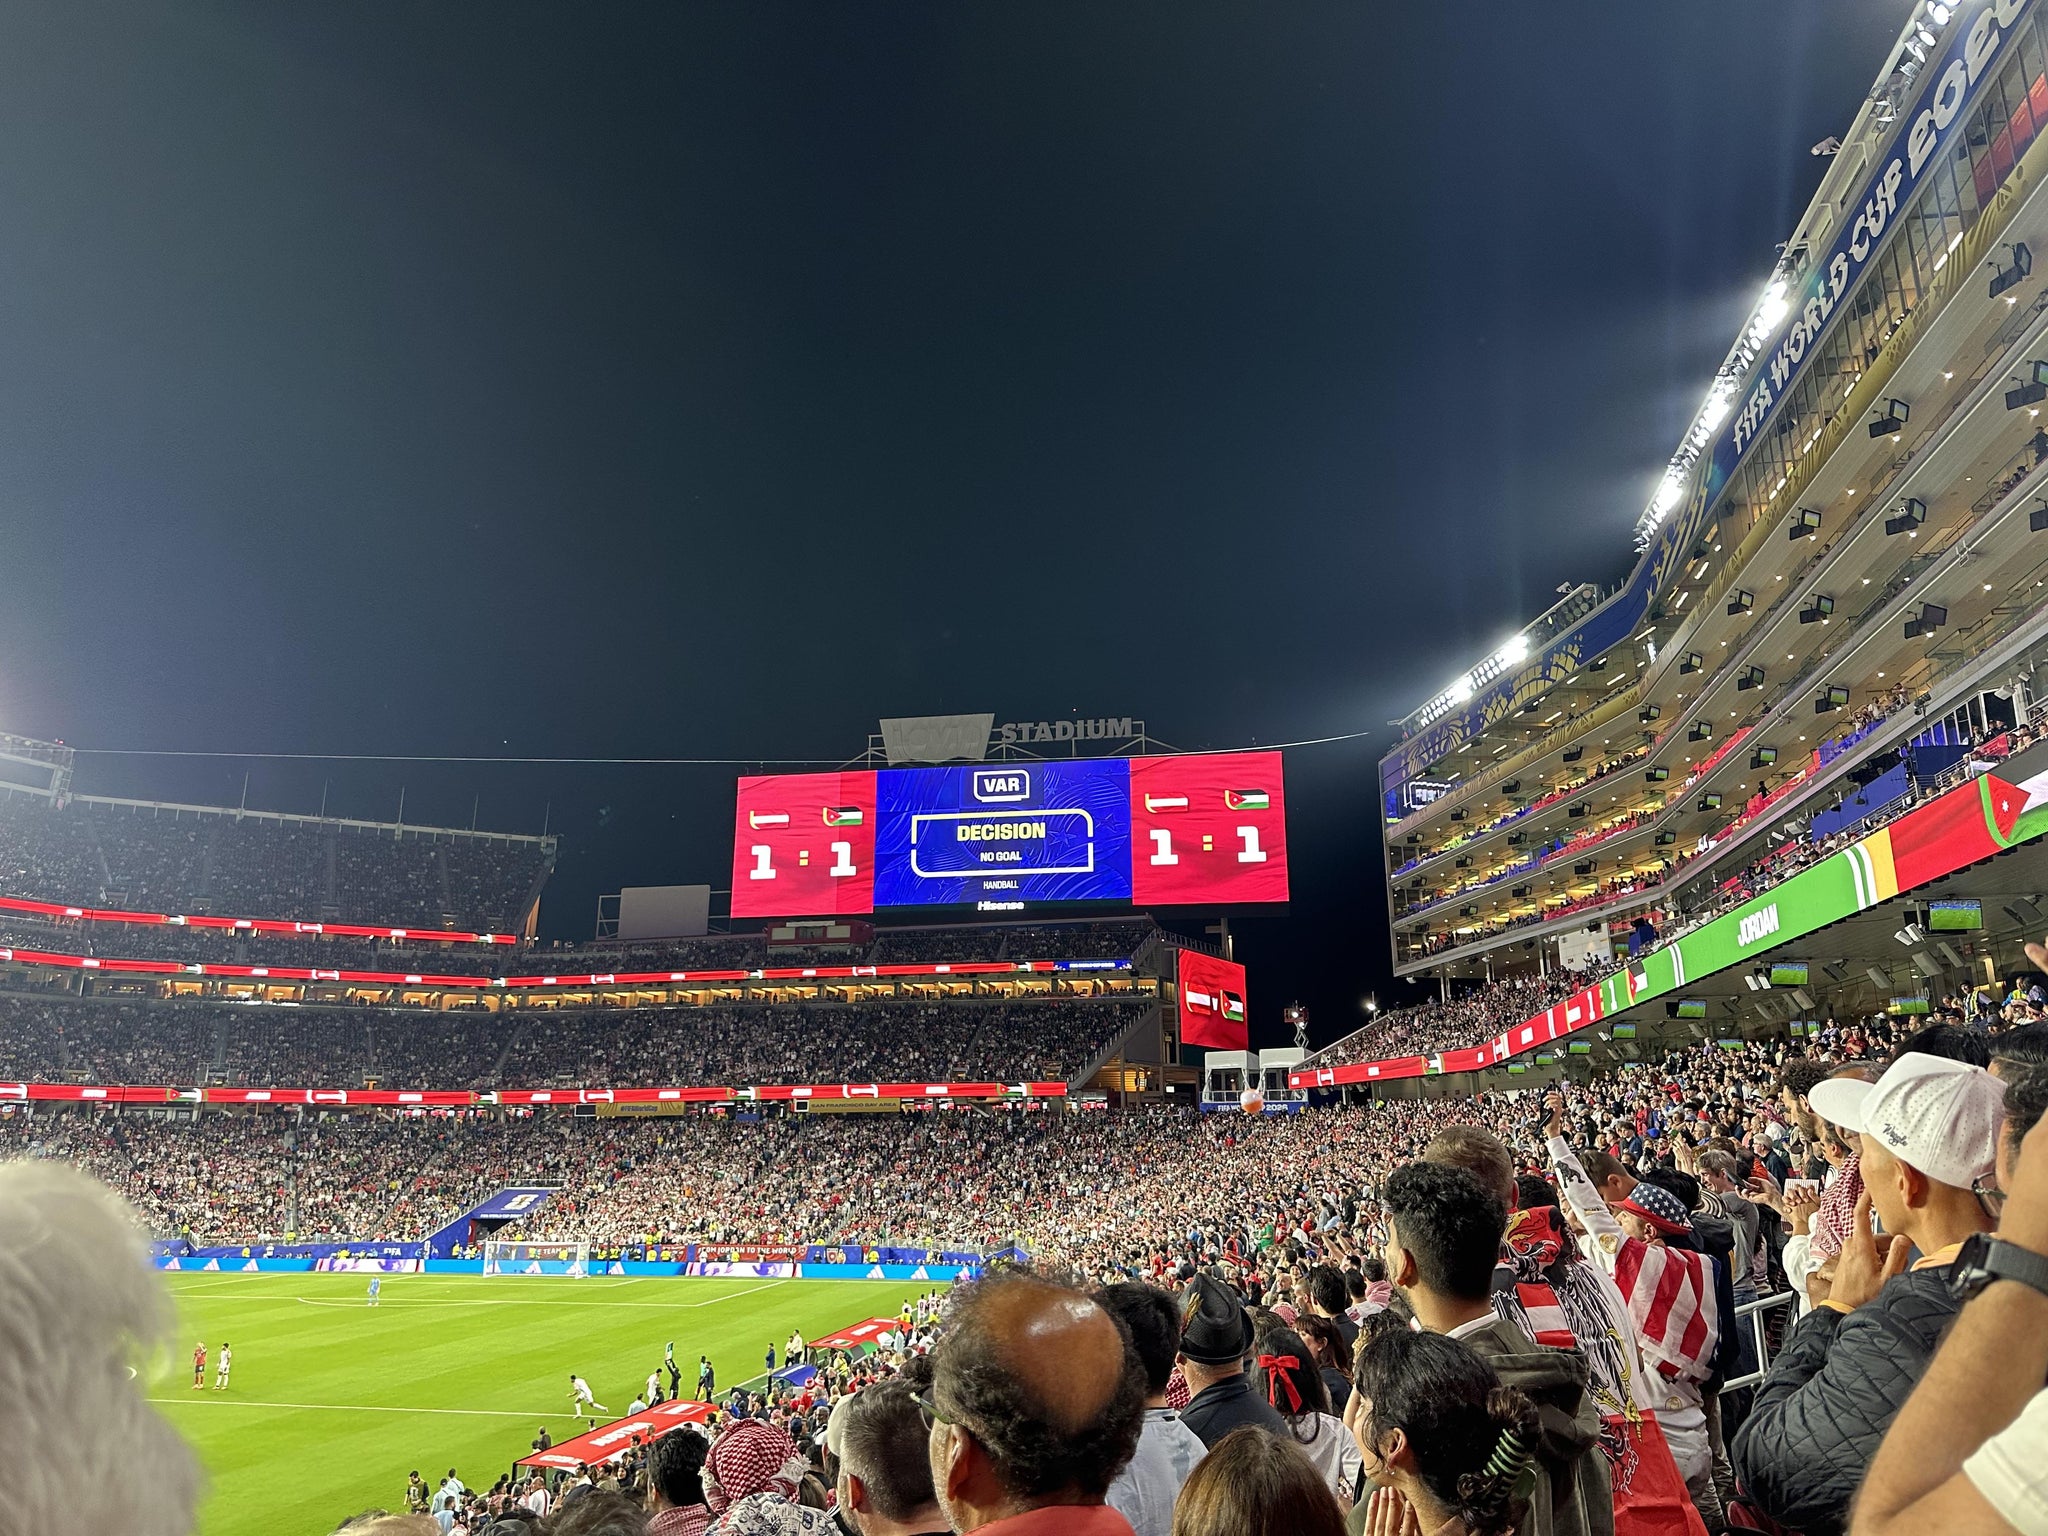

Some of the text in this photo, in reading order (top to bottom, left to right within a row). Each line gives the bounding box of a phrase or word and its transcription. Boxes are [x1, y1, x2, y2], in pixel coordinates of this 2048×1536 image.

[1733, 377, 1774, 456] FIFA
[1769, 251, 1850, 393] WORLD
[1848, 157, 1903, 263] CUP
[1001, 717, 1133, 743] STADIUM
[983, 777, 1020, 793] VAR
[956, 822, 1046, 842] DECISION
[1149, 829, 1179, 865] 1
[1236, 825, 1267, 863] 1
[750, 844, 776, 880] 1
[830, 840, 857, 877] 1
[980, 850, 1022, 862] NO GOAL
[983, 879, 1019, 890] HANDBALL
[977, 900, 1025, 911] Hisense
[1737, 903, 1780, 947] JORDAN
[384, 1247, 402, 1256] FIFA
